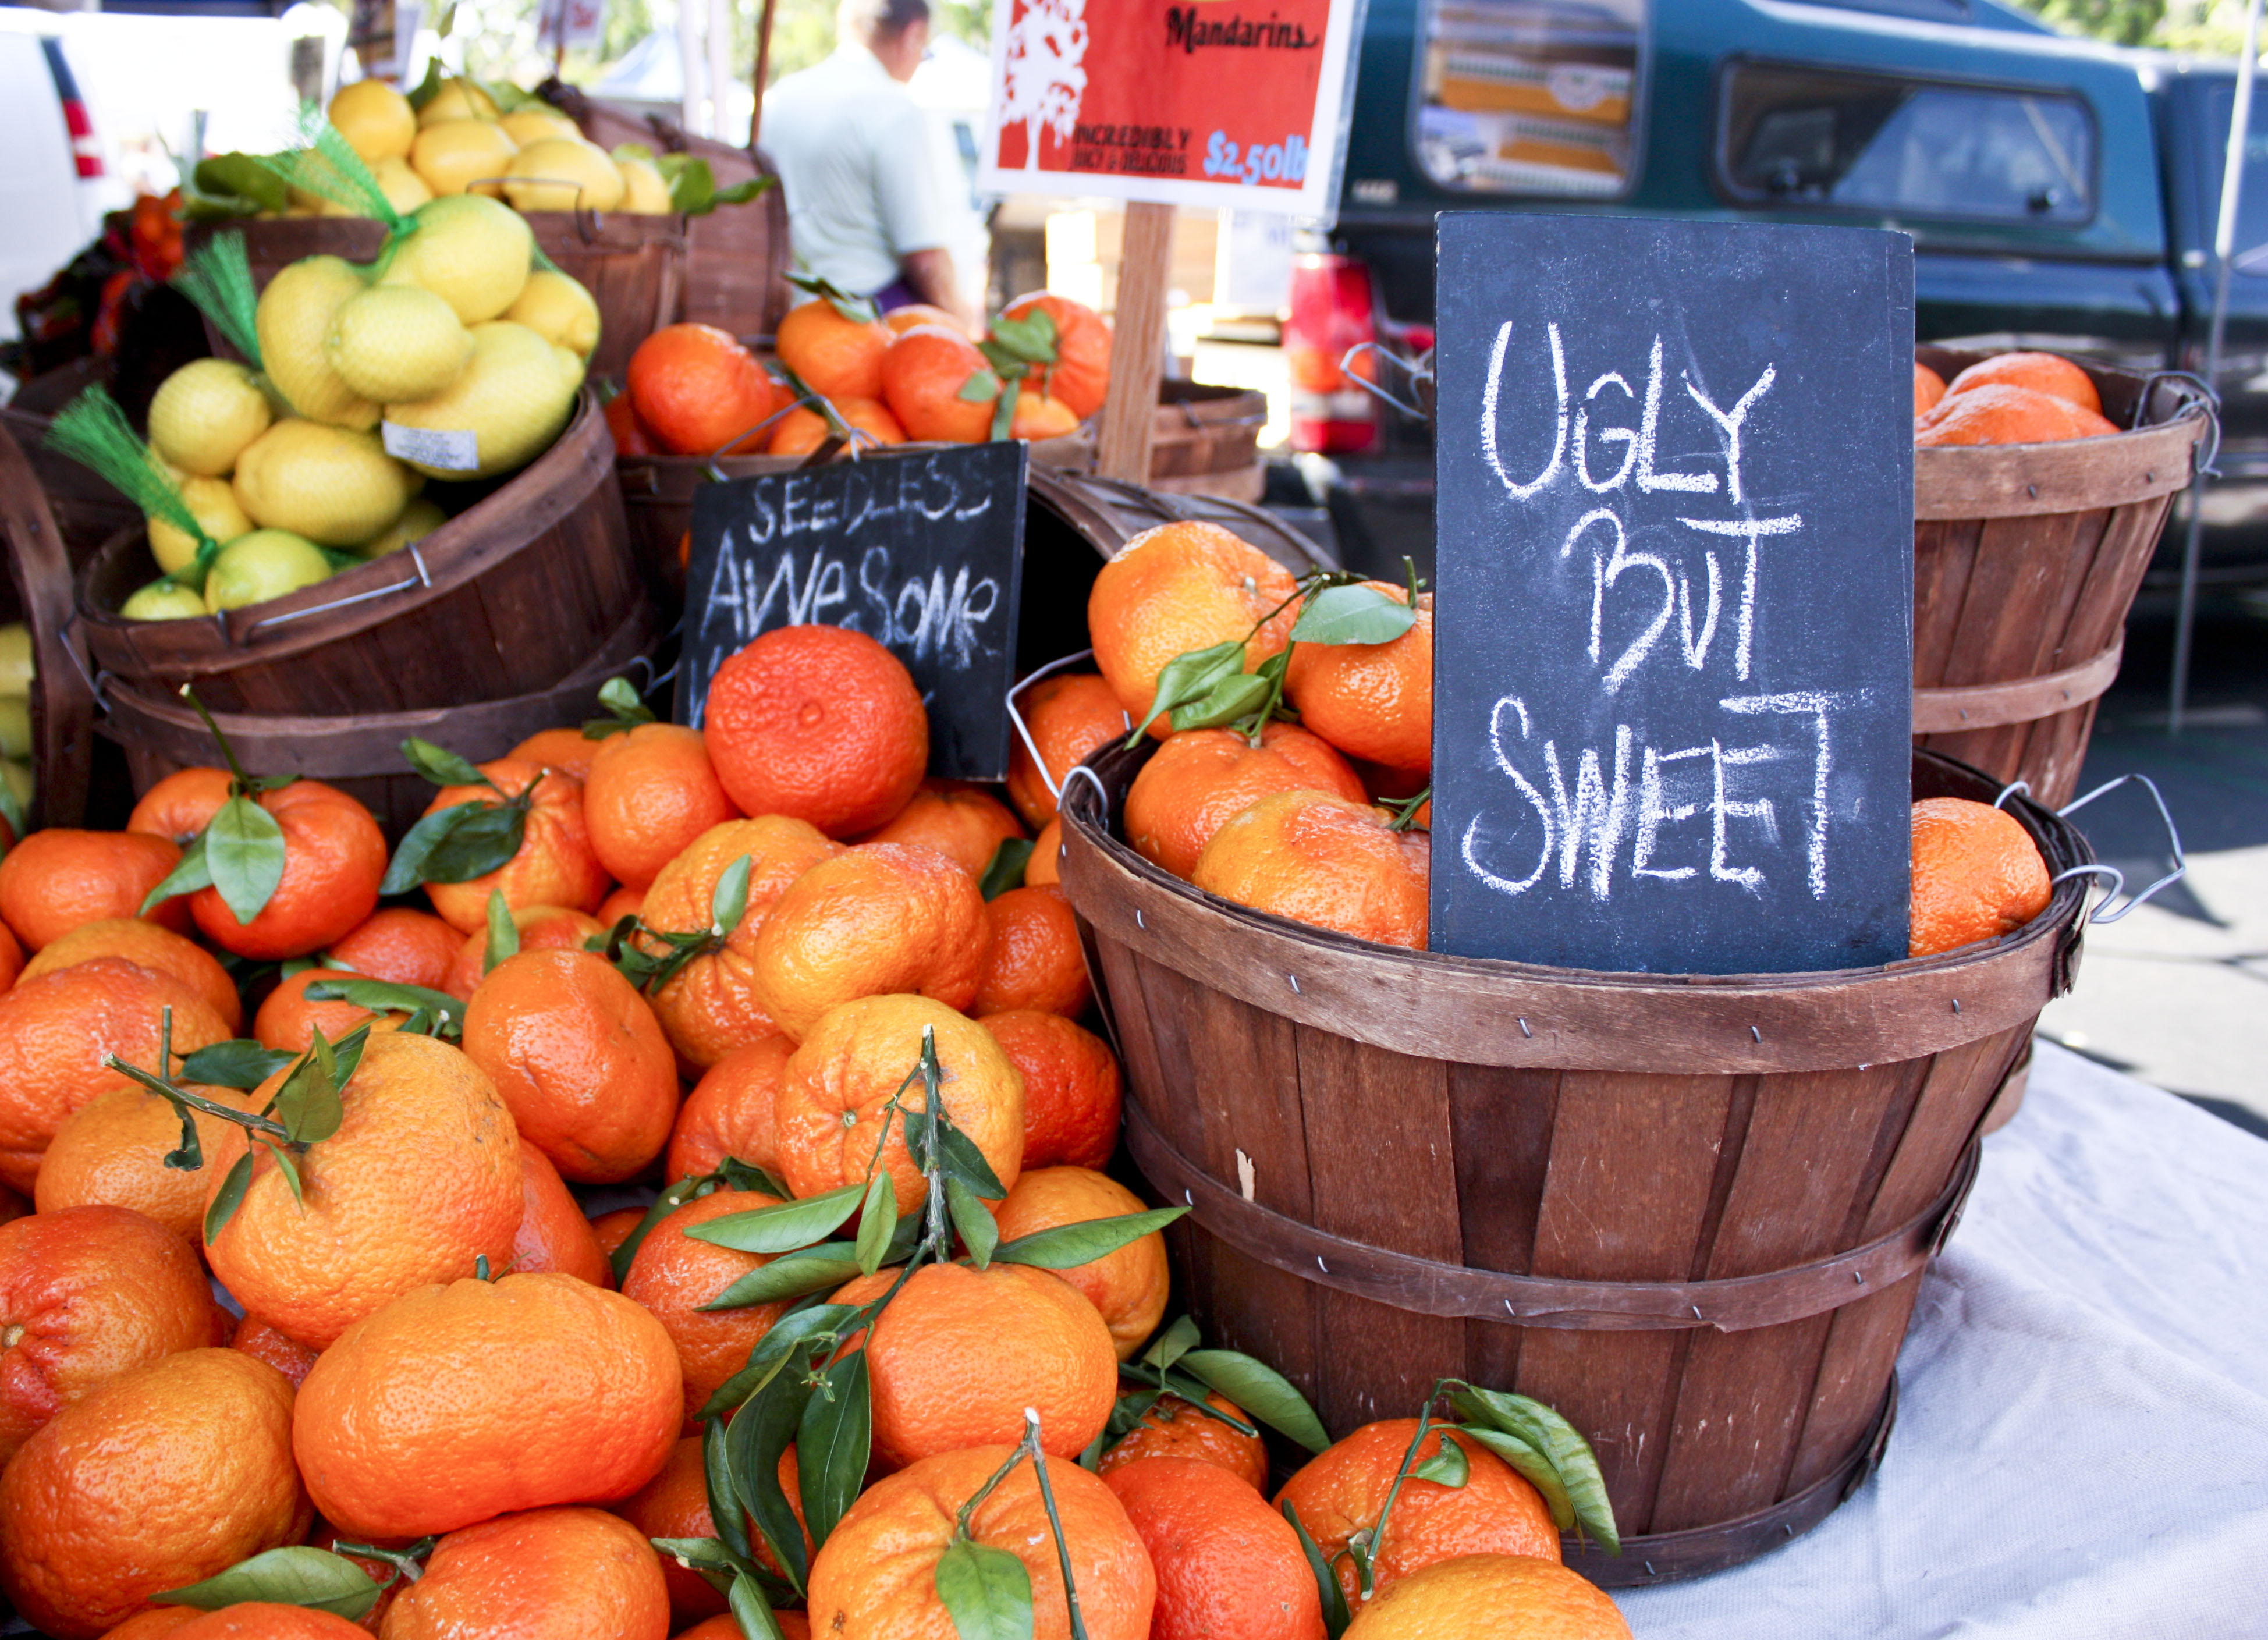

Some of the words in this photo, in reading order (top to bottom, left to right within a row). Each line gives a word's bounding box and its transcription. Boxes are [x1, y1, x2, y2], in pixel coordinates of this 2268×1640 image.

[1166, 6, 1320, 54] Mandarins
[1072, 123, 1191, 150] INCREDIBLY
[1480, 321, 1776, 505] UGLY
[1560, 508, 1803, 696] BUT
[1461, 690, 1865, 902] SWEET
